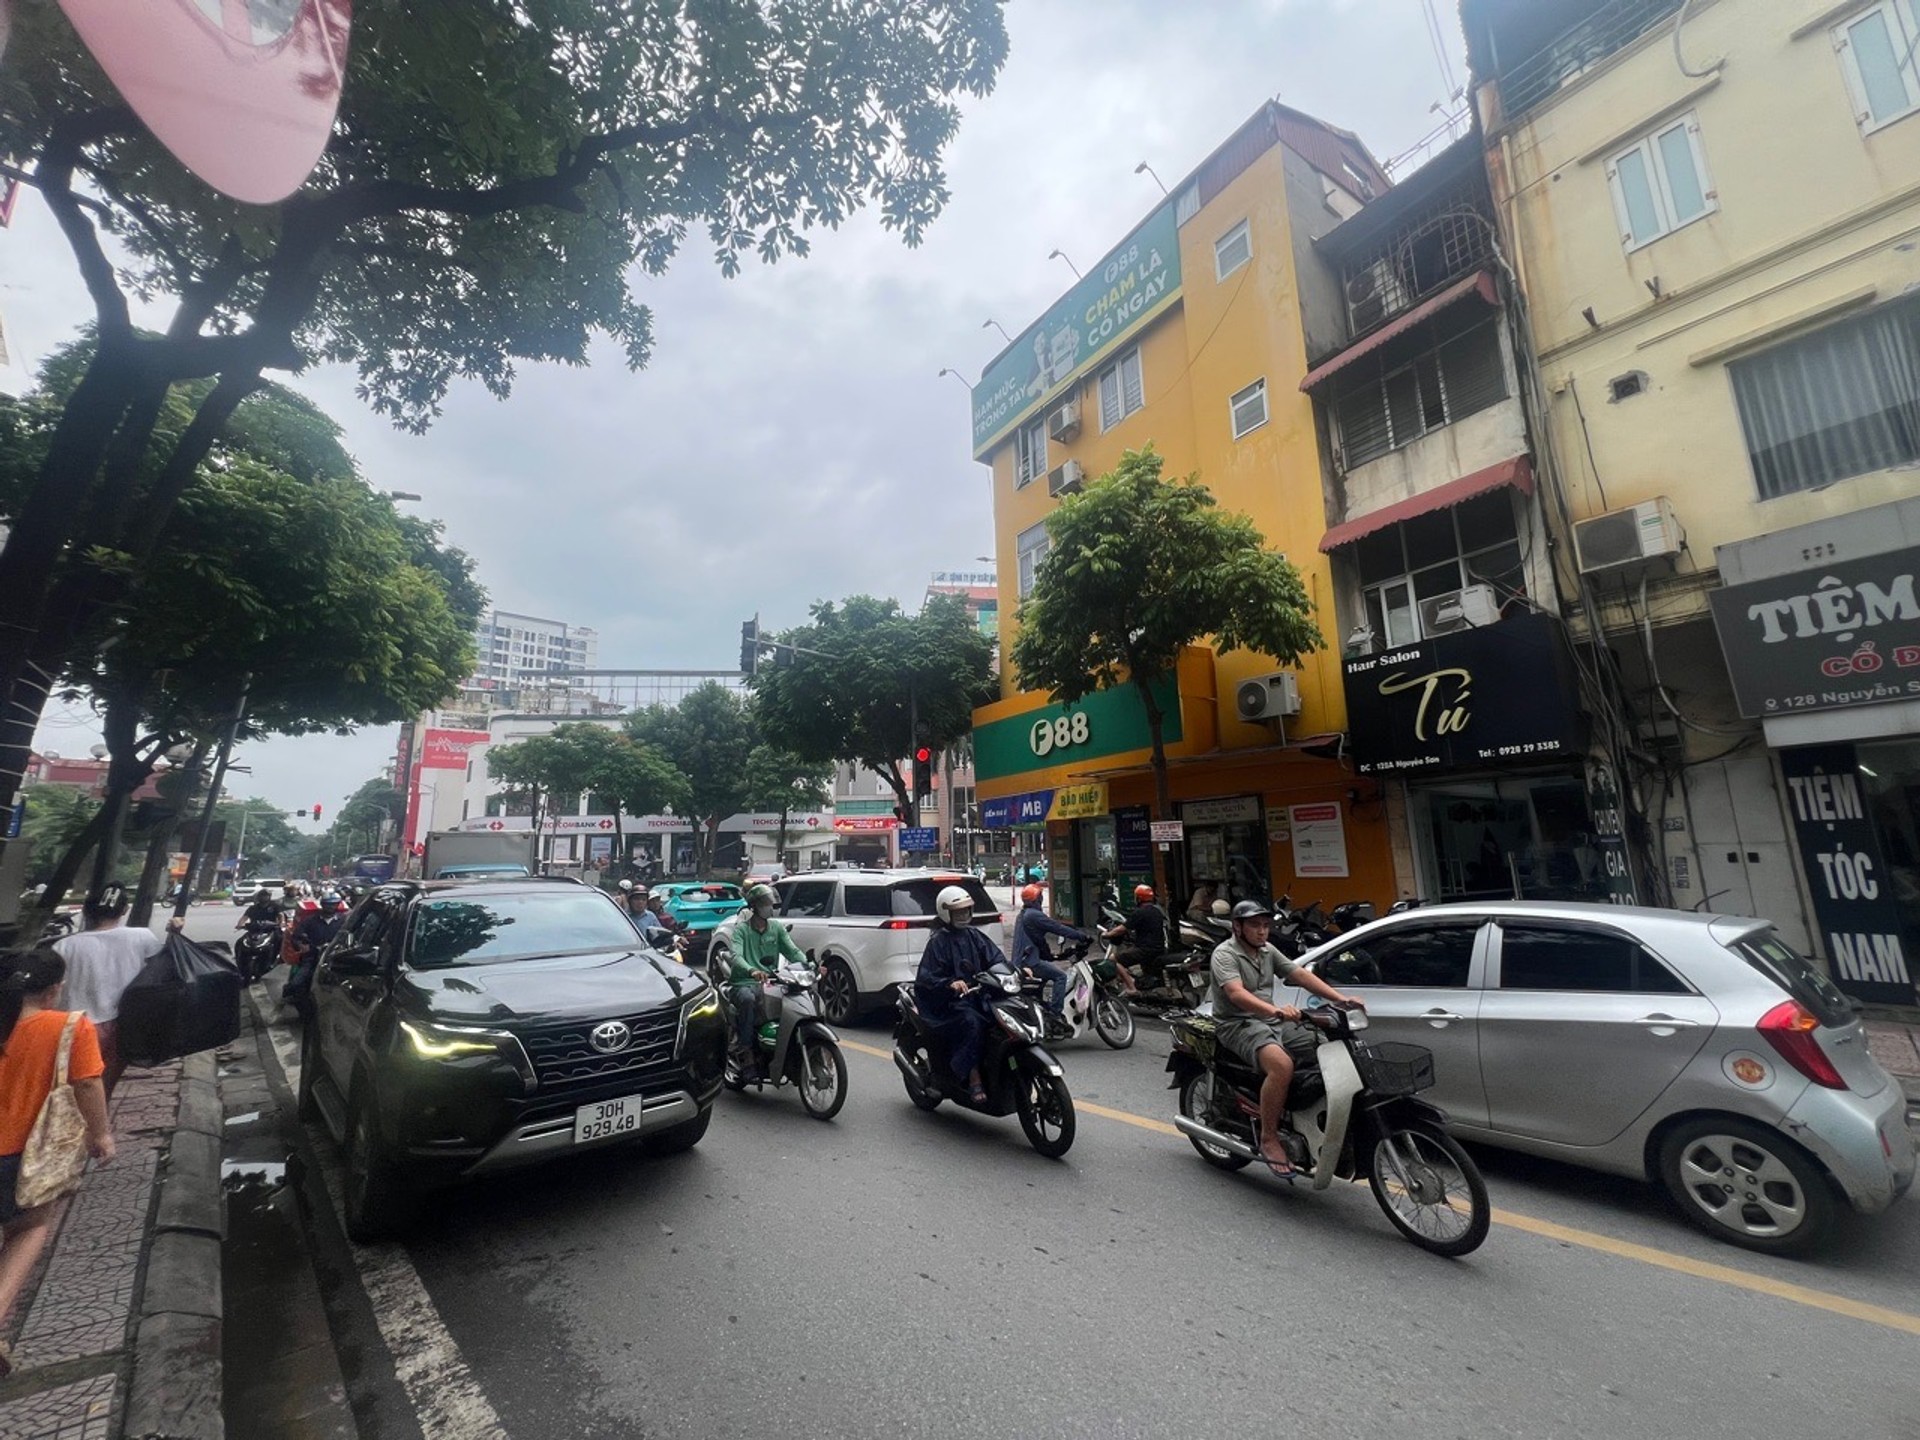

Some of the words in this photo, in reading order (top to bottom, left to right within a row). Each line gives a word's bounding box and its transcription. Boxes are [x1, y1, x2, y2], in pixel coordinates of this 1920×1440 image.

[1085, 271, 1135, 324] CHẠM
[1088, 314, 1112, 346] CÓ
[1116, 269, 1167, 324] NGAY
[1747, 575, 1920, 643] TIỆM
[1348, 660, 1376, 674] Hair
[1380, 650, 1420, 666] Salon
[1821, 640, 1883, 677] CỔ
[1784, 694, 1817, 708] 128
[1823, 682, 1901, 705] Nguyễn
[1030, 712, 1089, 756] F88
[1022, 800, 1042, 817] MB
[1789, 766, 1864, 832] TIỆM
[1132, 820, 1148, 832] MB
[1604, 850, 1628, 877] GIA
[1816, 841, 1879, 900] TÓC
[1830, 932, 1910, 984] NAM
[582, 1114, 634, 1140] 929.48
[595, 1102, 624, 1120] 30H
